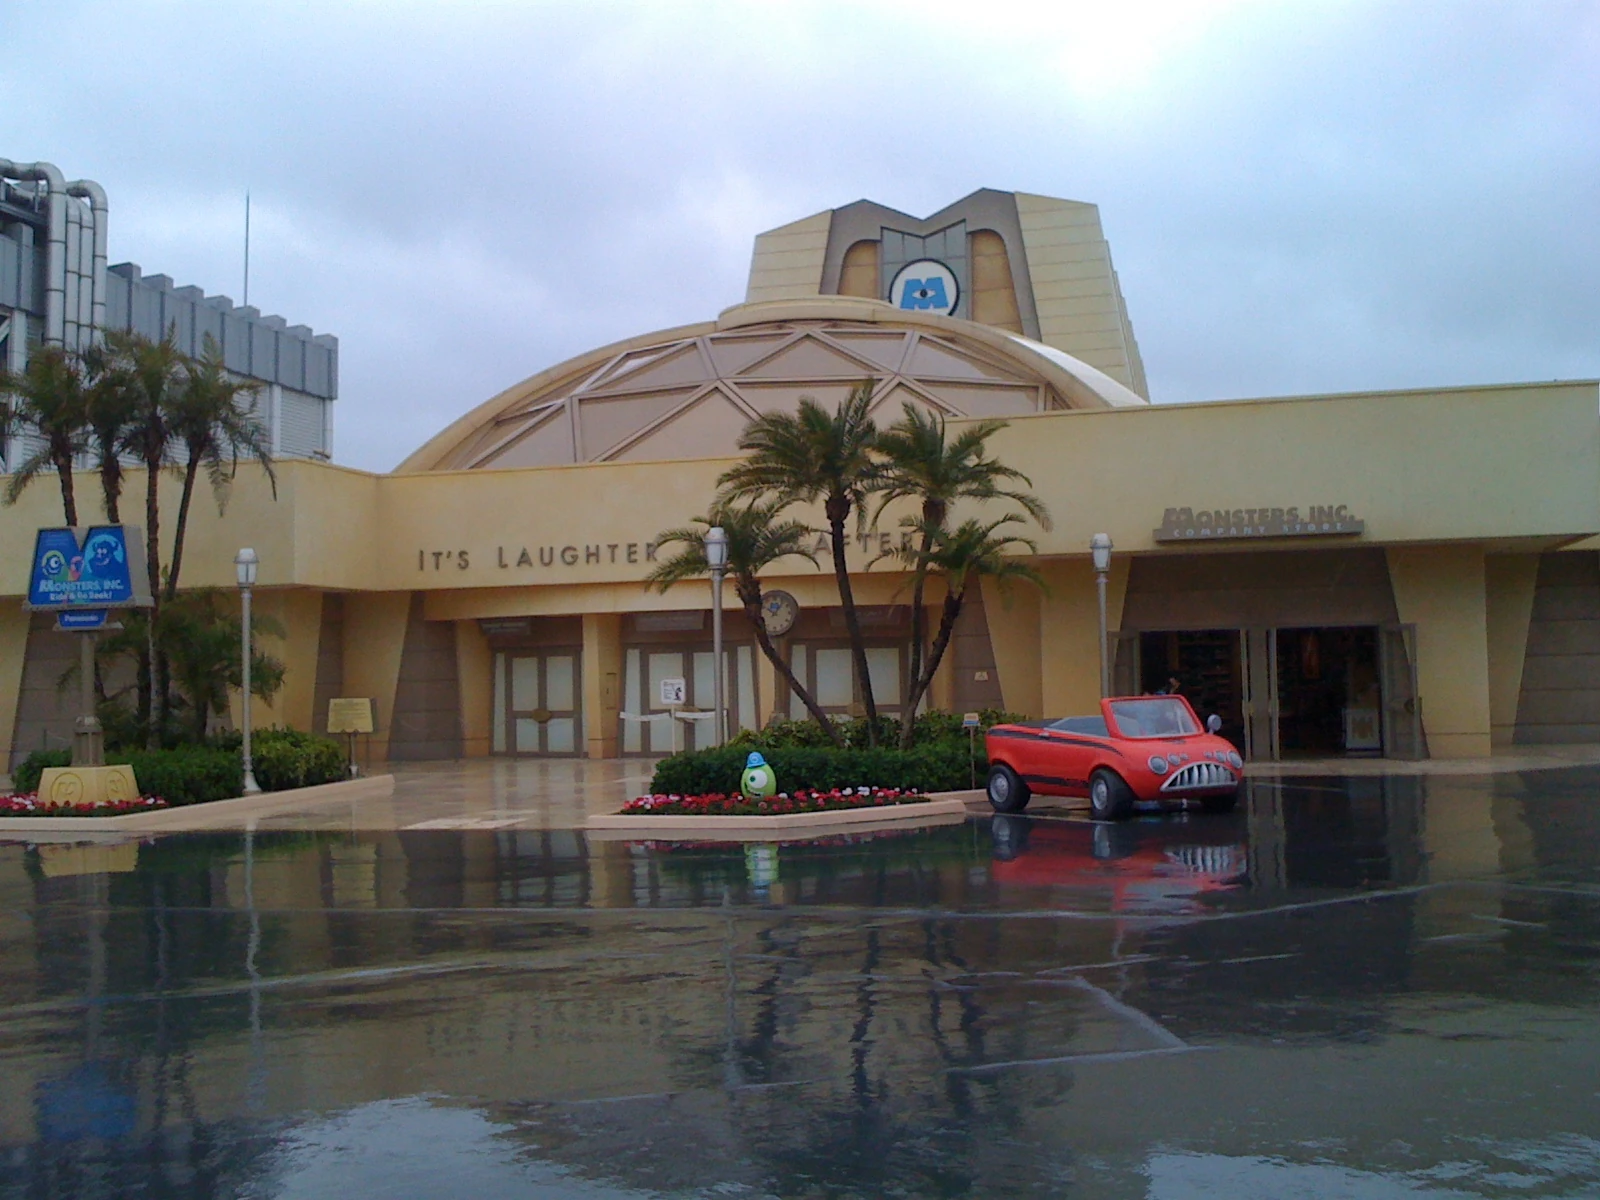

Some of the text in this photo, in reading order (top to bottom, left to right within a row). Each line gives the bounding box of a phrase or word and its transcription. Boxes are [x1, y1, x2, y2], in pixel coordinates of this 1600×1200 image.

[1308, 504, 1355, 523] INC.
[1173, 522, 1344, 538] COMPANY STORE
[417, 549, 470, 571] IT'S
[497, 543, 659, 569] LAUGHTER
